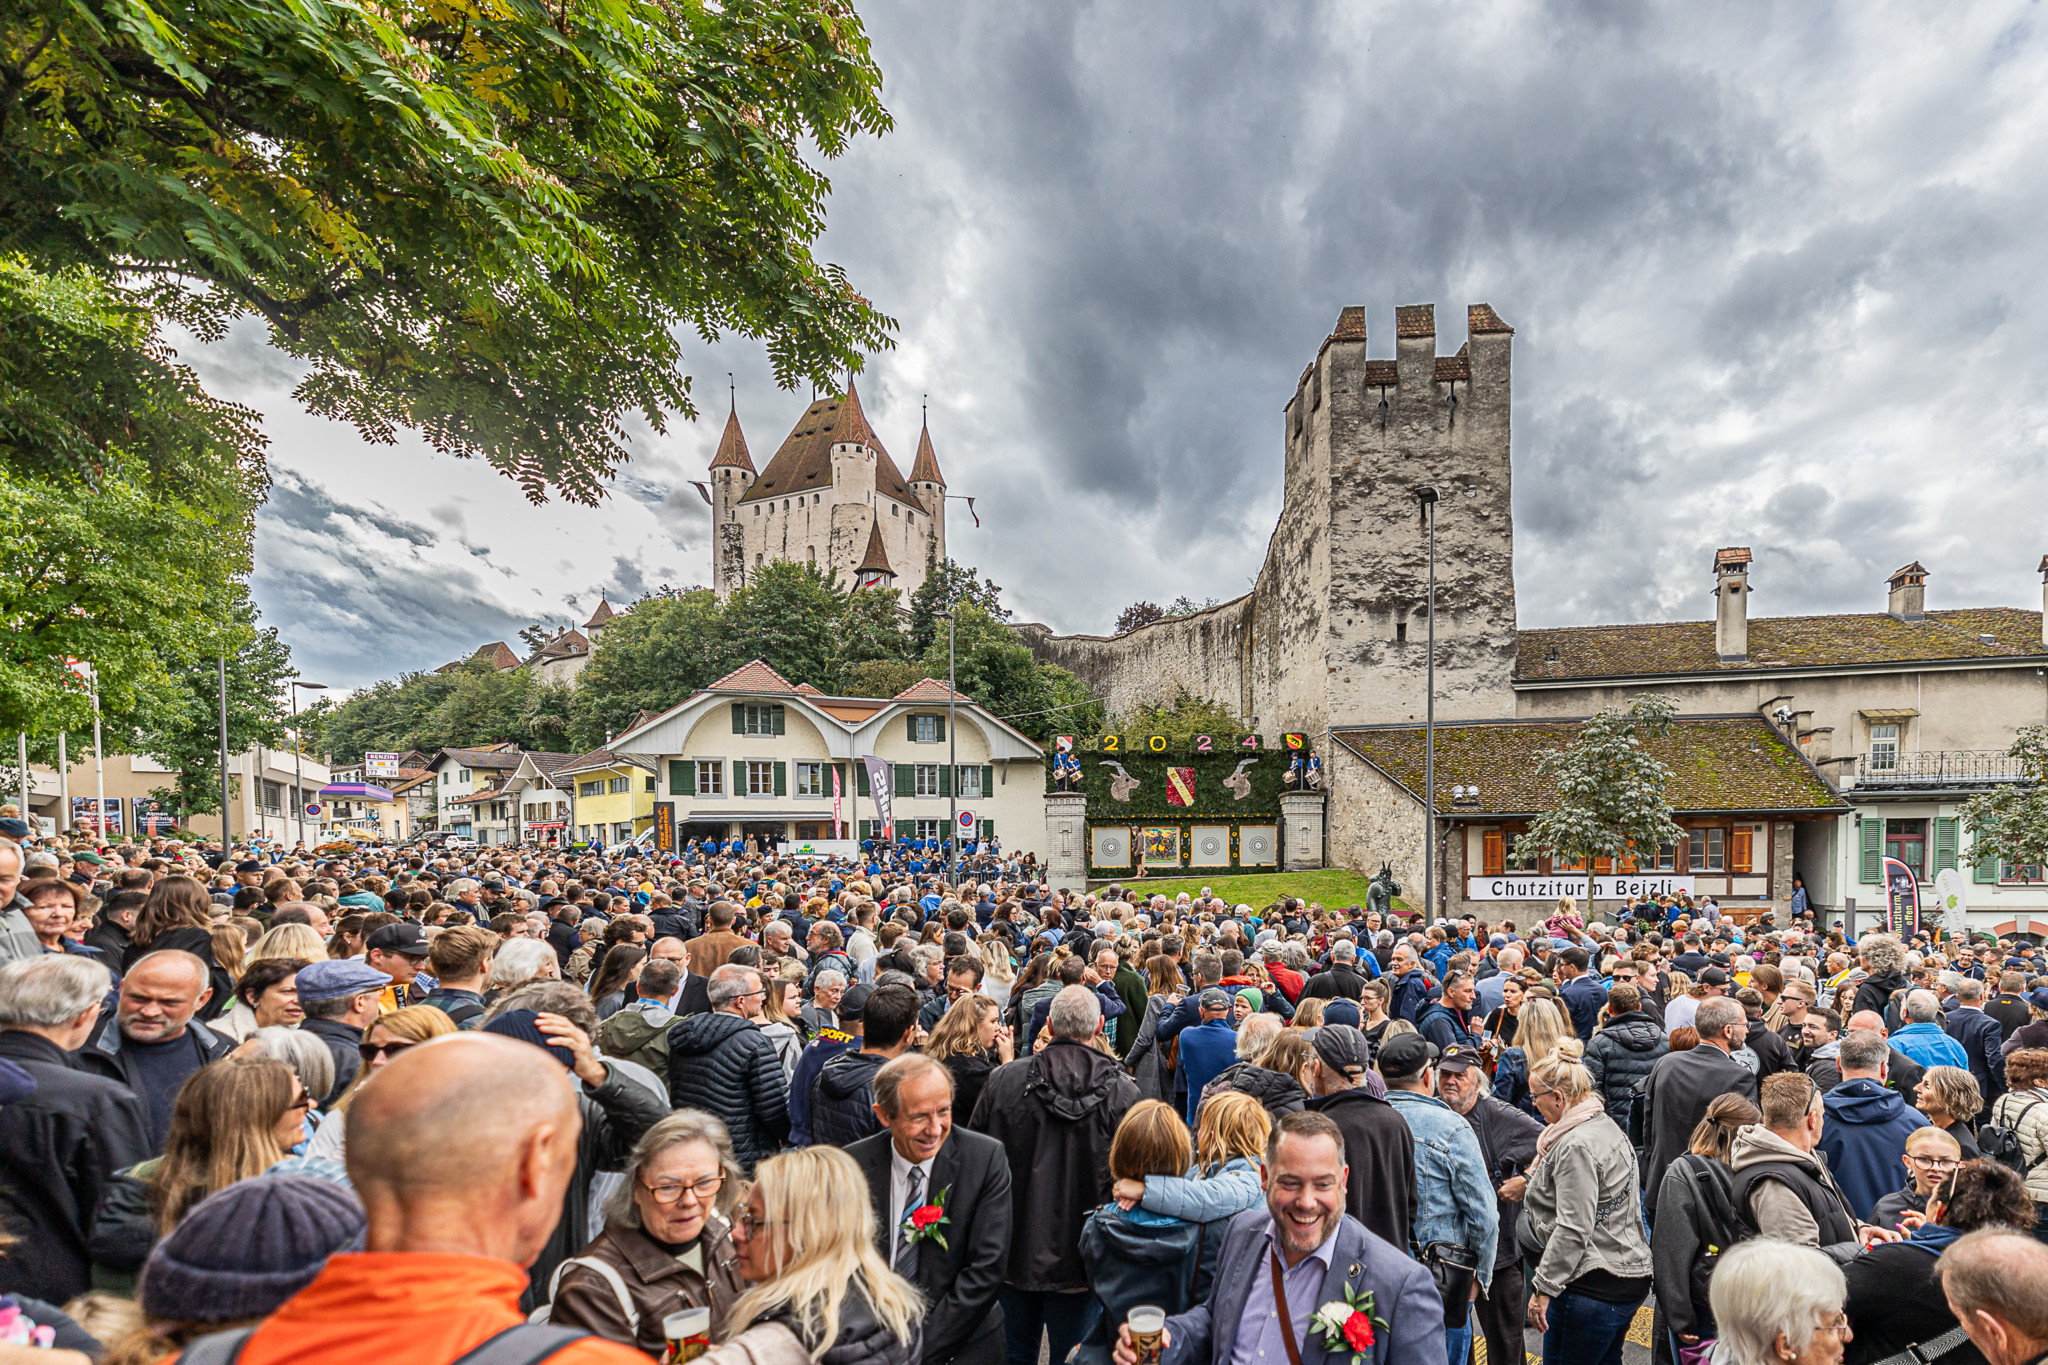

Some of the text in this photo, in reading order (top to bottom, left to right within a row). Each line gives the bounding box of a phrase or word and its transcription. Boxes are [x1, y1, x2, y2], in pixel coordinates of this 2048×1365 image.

[1491, 879, 1672, 896] Chutziturm Beizli
[1904, 905, 1913, 926] offen
